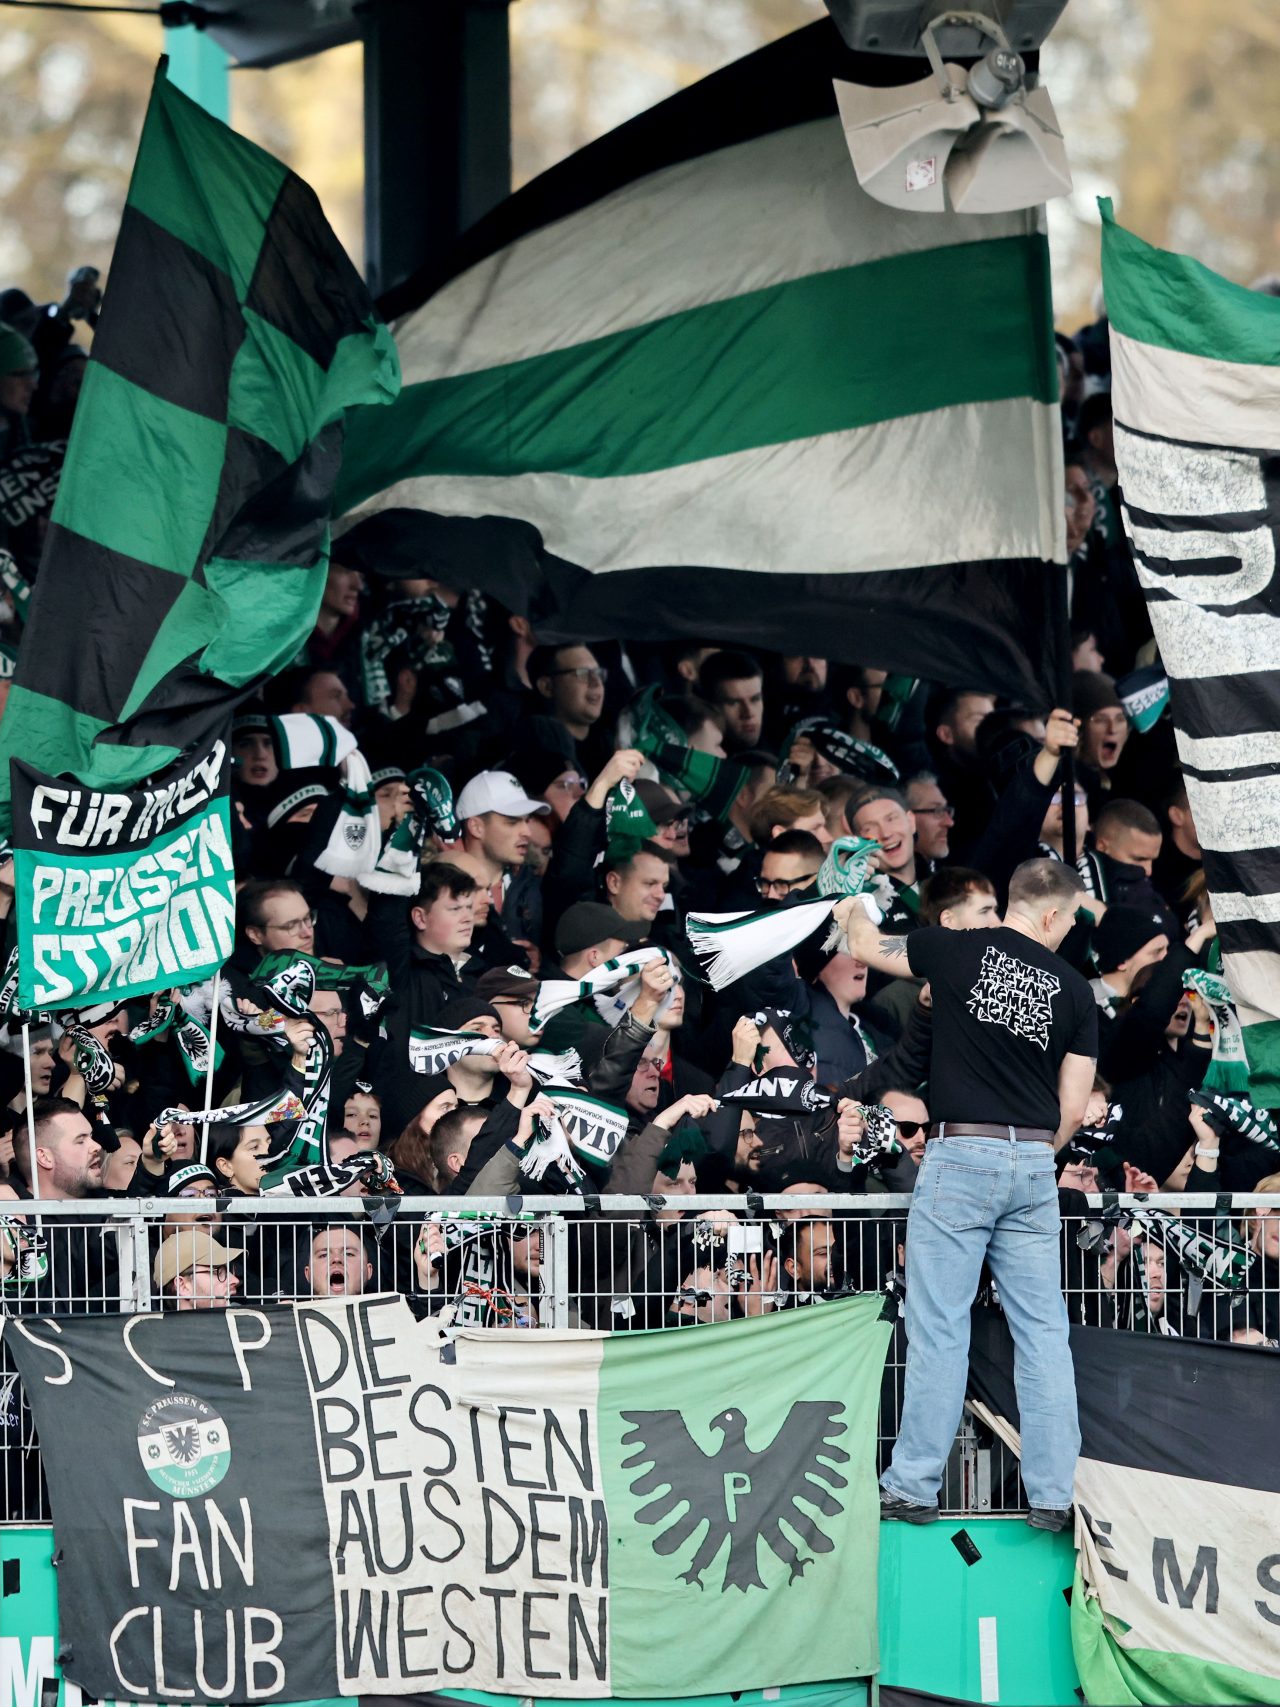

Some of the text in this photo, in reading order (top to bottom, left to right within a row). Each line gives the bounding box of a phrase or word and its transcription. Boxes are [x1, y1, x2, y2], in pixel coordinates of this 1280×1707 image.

[30, 785, 132, 847] FÜR
[298, 1295, 411, 1392] DIE
[151, 1396, 197, 1413] PREUSSEN
[198, 1403, 209, 1415] 06
[317, 1384, 595, 1492] BESTEN
[172, 1475, 217, 1496] MÜNSTER
[335, 1478, 609, 1589] AUS DEM
[123, 1496, 254, 1592] FAN
[110, 1605, 287, 1700] CLUB
[341, 1583, 607, 1681] WESTEN
